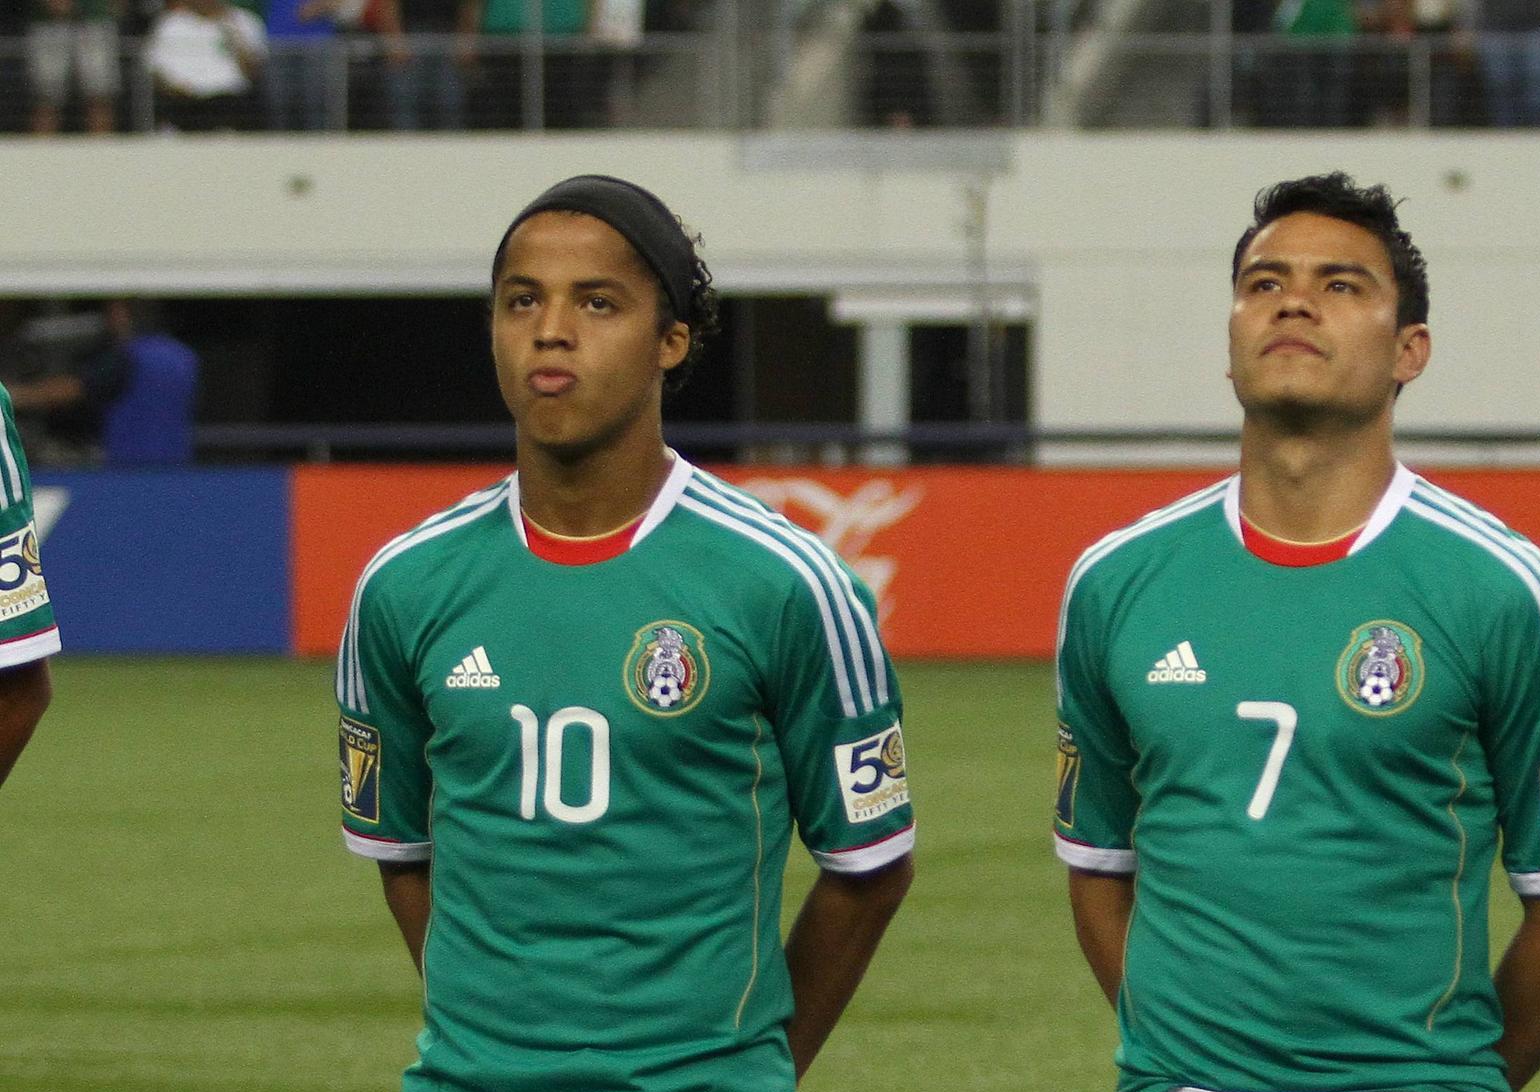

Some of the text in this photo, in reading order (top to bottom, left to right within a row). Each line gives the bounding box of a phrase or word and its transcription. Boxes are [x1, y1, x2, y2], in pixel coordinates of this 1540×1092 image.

[446, 672, 501, 688] adidas
[1148, 667, 1207, 683] adidas
[511, 704, 610, 823] 10
[1236, 701, 1298, 820] 7
